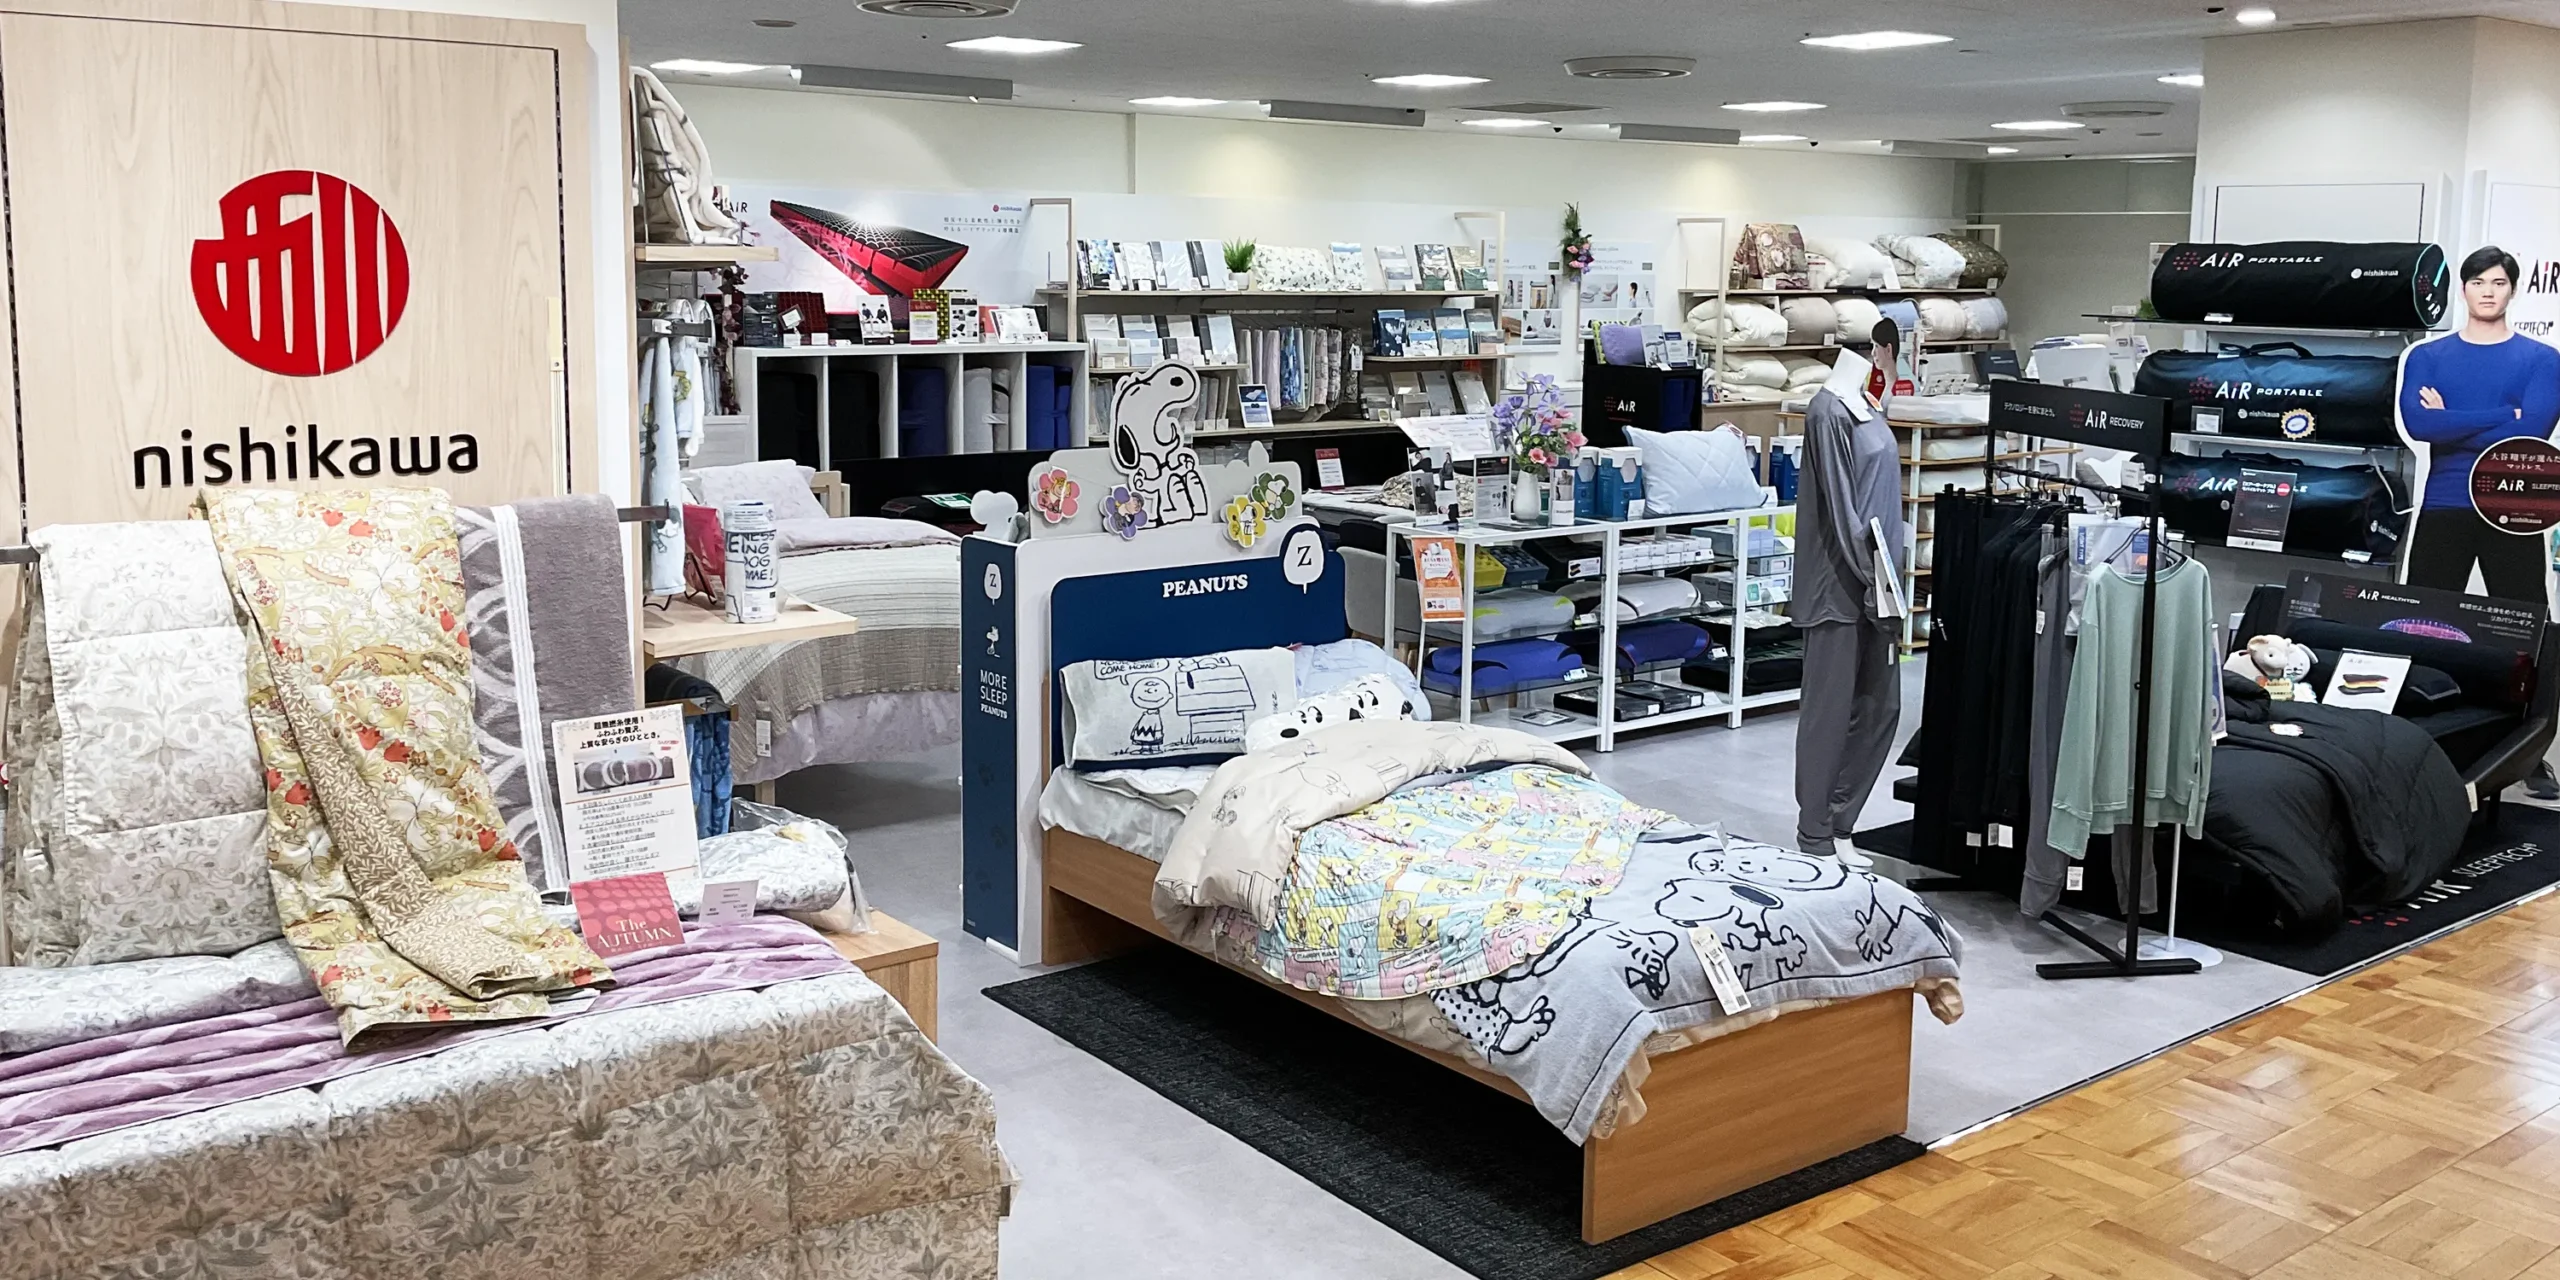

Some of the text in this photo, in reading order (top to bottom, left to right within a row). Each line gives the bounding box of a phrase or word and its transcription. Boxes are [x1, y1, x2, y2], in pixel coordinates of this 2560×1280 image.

[2200, 252, 2324, 268] AiR PORTABLE
[2363, 269, 2399, 277] nishikawa
[2527, 258, 2560, 294] AiR
[2215, 380, 2324, 400] AiR PORTABLE
[1617, 399, 1636, 412] AiR
[2085, 409, 2145, 430] AiR RECOVERY
[2248, 410, 2280, 418] nishikawa
[133, 424, 479, 489] nishikawa
[2198, 477, 2238, 492] AiR
[2497, 478, 2525, 492] AiR
[1297, 545, 1312, 567] Z
[989, 574, 997, 588] Z
[1162, 574, 1249, 598] PEANUTS
[2357, 589, 2380, 601] AiR
[1100, 665, 1125, 676] COME
[1128, 661, 1160, 670] HOME!
[980, 669, 1008, 690] MORE
[980, 685, 1008, 706] SLEEP
[980, 703, 1008, 719] PEANUTS
[2452, 845, 2543, 878] SLEEPTECH
[615, 918, 647, 932] The
[597, 926, 676, 949] AUTUMN.
